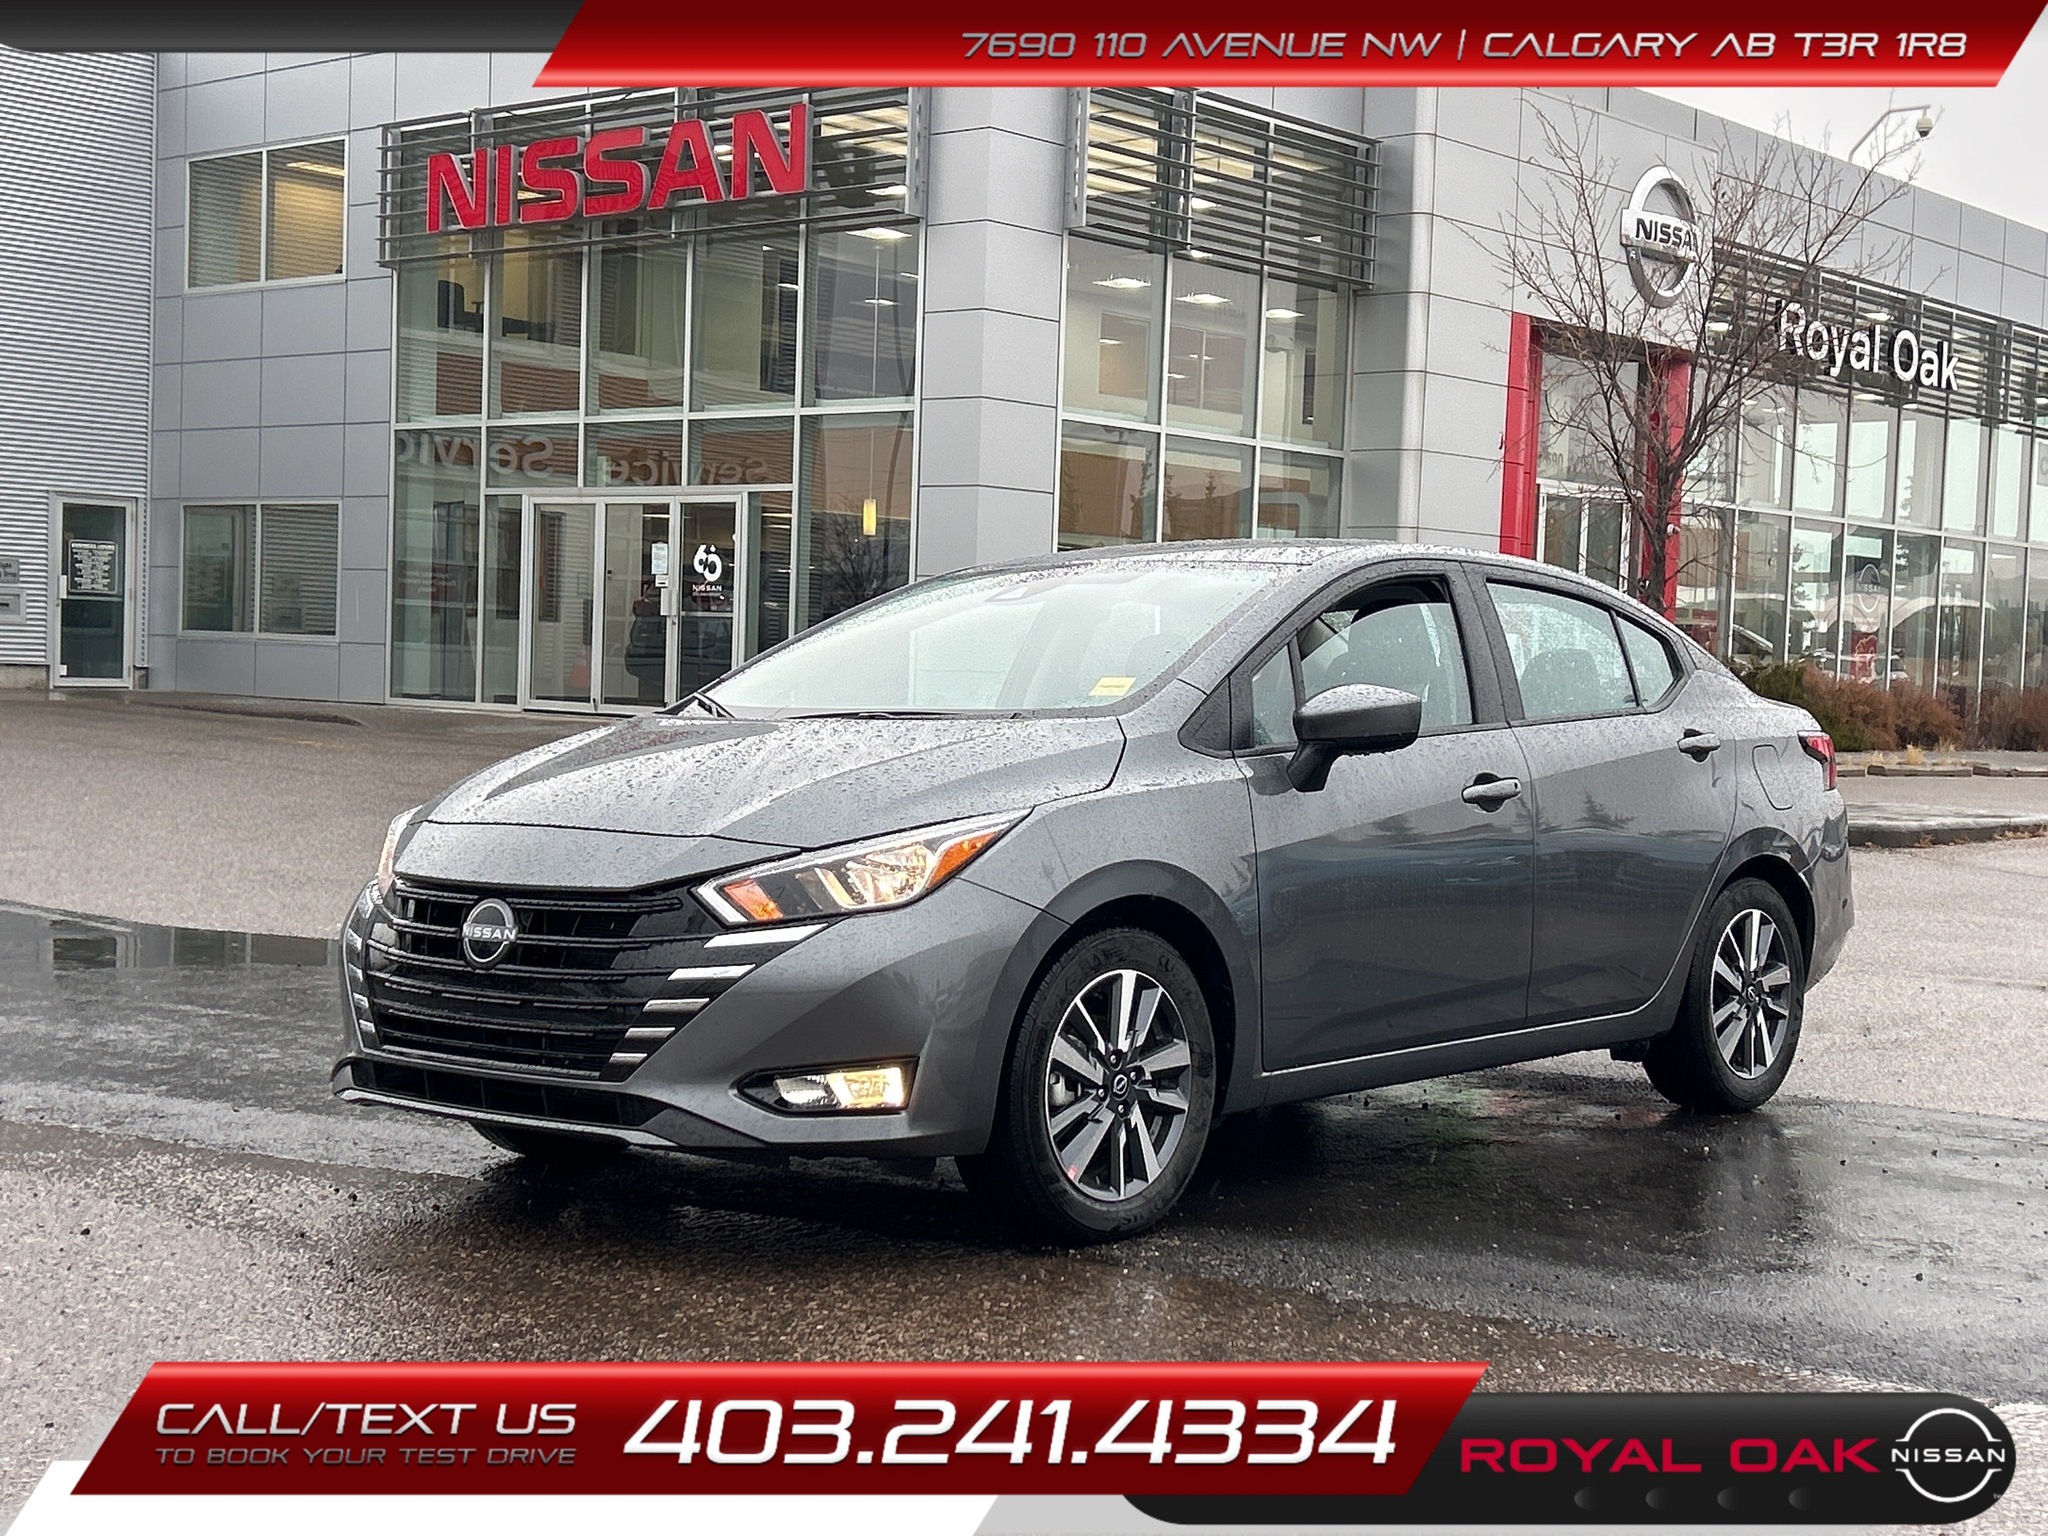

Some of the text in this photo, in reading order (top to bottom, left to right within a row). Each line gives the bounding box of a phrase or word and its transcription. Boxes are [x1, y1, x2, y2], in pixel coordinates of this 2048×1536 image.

[426, 103, 812, 234] NISSAN
[1777, 300, 1959, 391] Royal Oak
[462, 924, 516, 940] NISSAN
